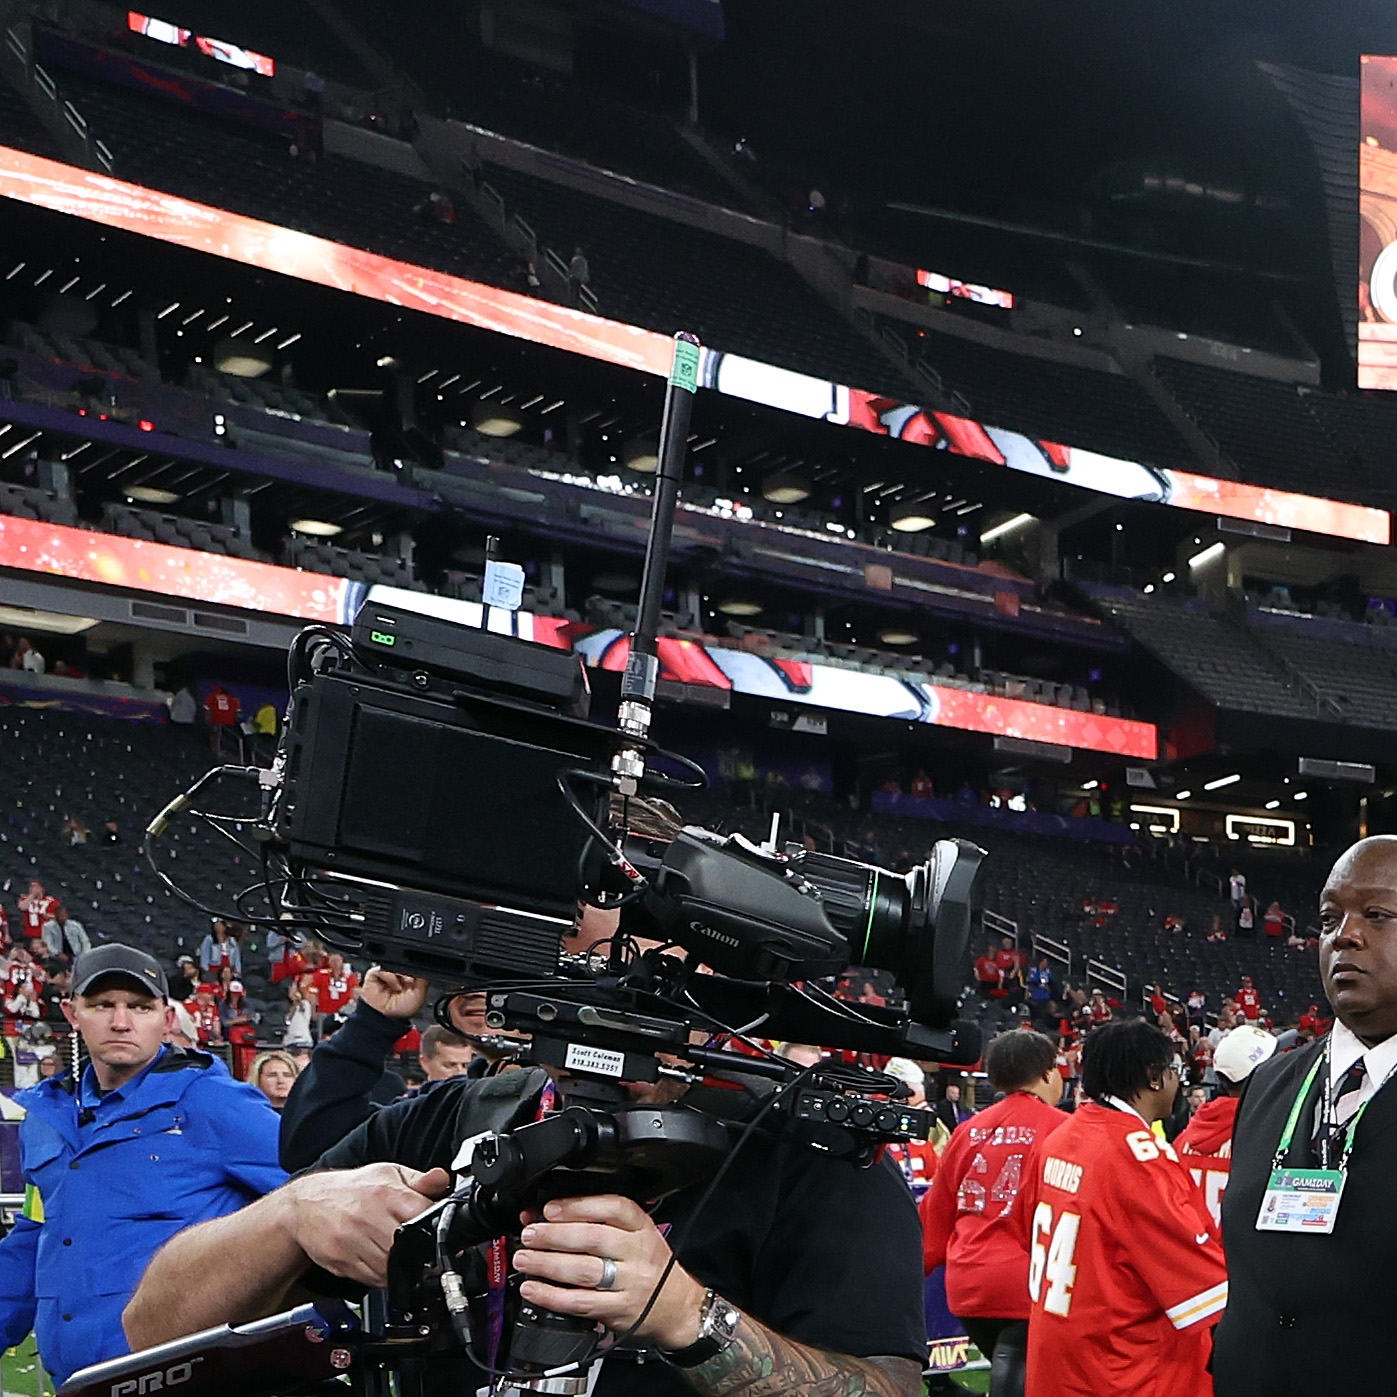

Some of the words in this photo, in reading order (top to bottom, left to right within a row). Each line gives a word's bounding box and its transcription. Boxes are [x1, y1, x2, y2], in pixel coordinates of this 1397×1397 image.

[689, 921, 740, 948] Canon
[572, 1047, 591, 1057] Scott
[593, 1051, 621, 1063] Coleman
[957, 1153, 1024, 1218] 64
[1043, 1156, 1083, 1194] MORRIS
[1293, 1177, 1334, 1188] GAMEDAY
[1028, 1202, 1081, 1317] 64
